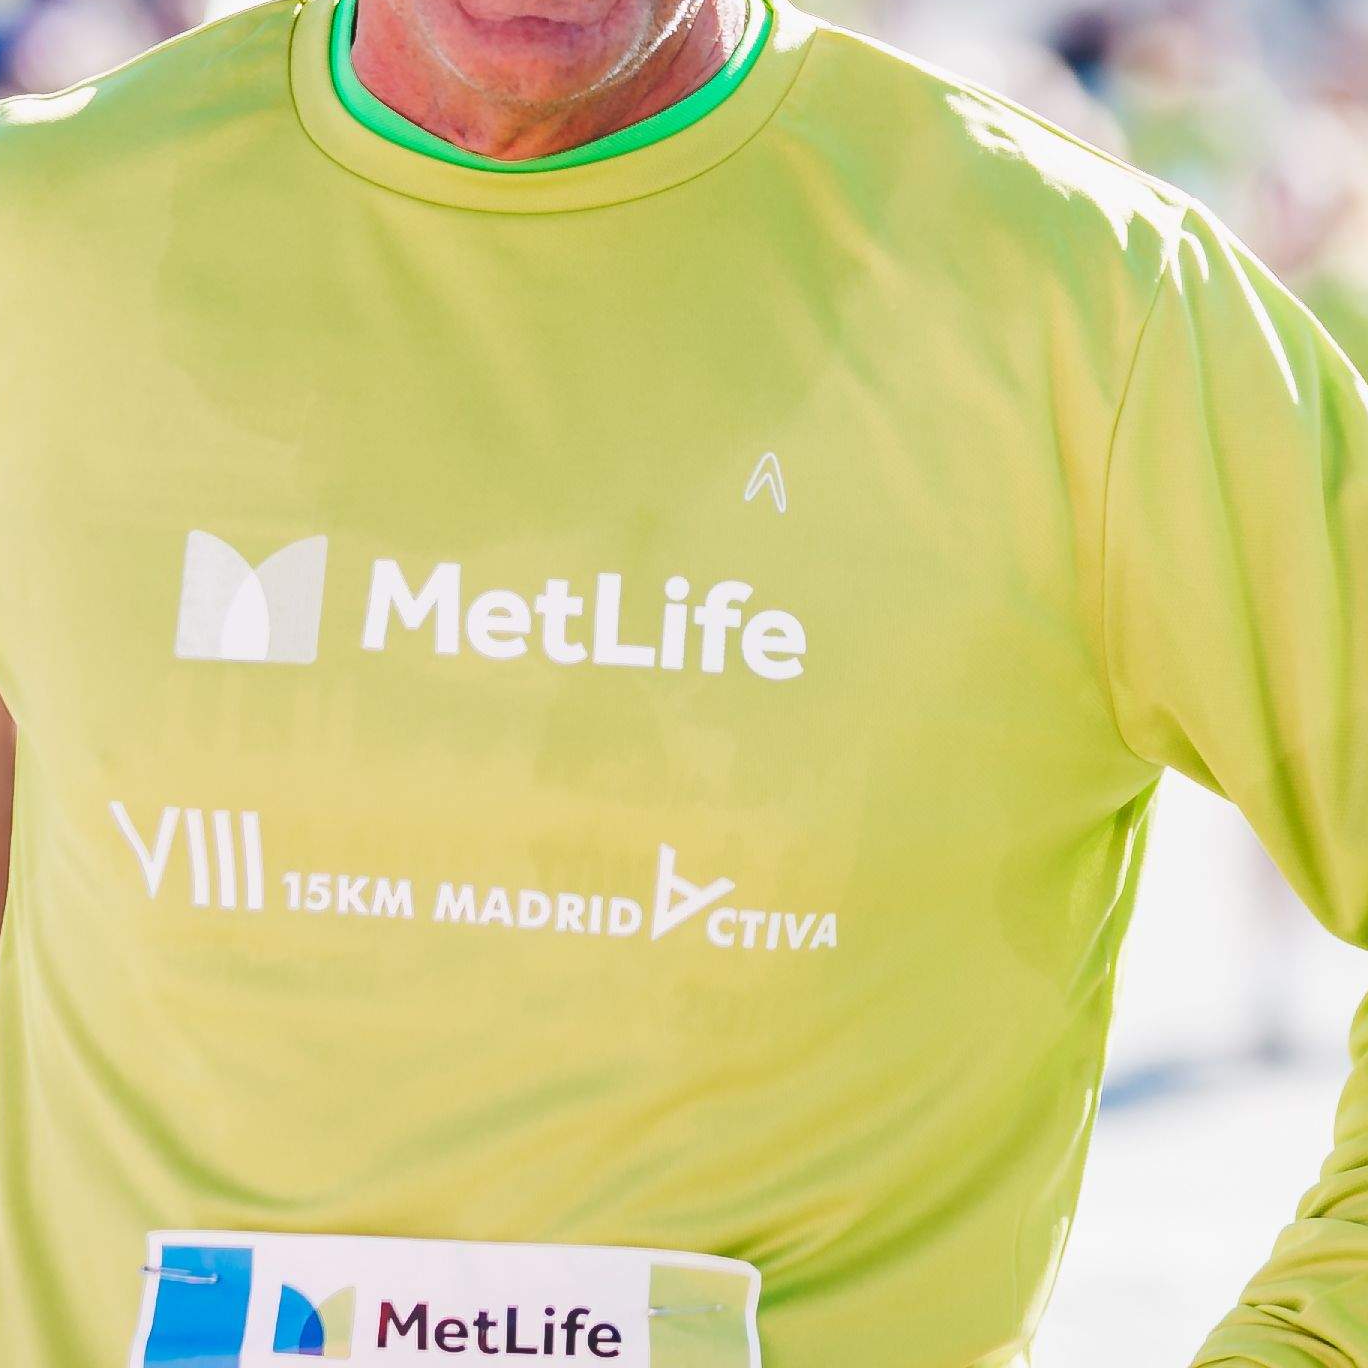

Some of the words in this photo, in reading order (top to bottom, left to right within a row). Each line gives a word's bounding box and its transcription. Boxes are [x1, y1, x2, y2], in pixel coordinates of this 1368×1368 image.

[362, 558, 807, 680] MetLife
[109, 801, 265, 910] VIII
[282, 871, 414, 919] 15KM
[433, 881, 642, 937] MADRID
[376, 1300, 622, 1359] MetLife
